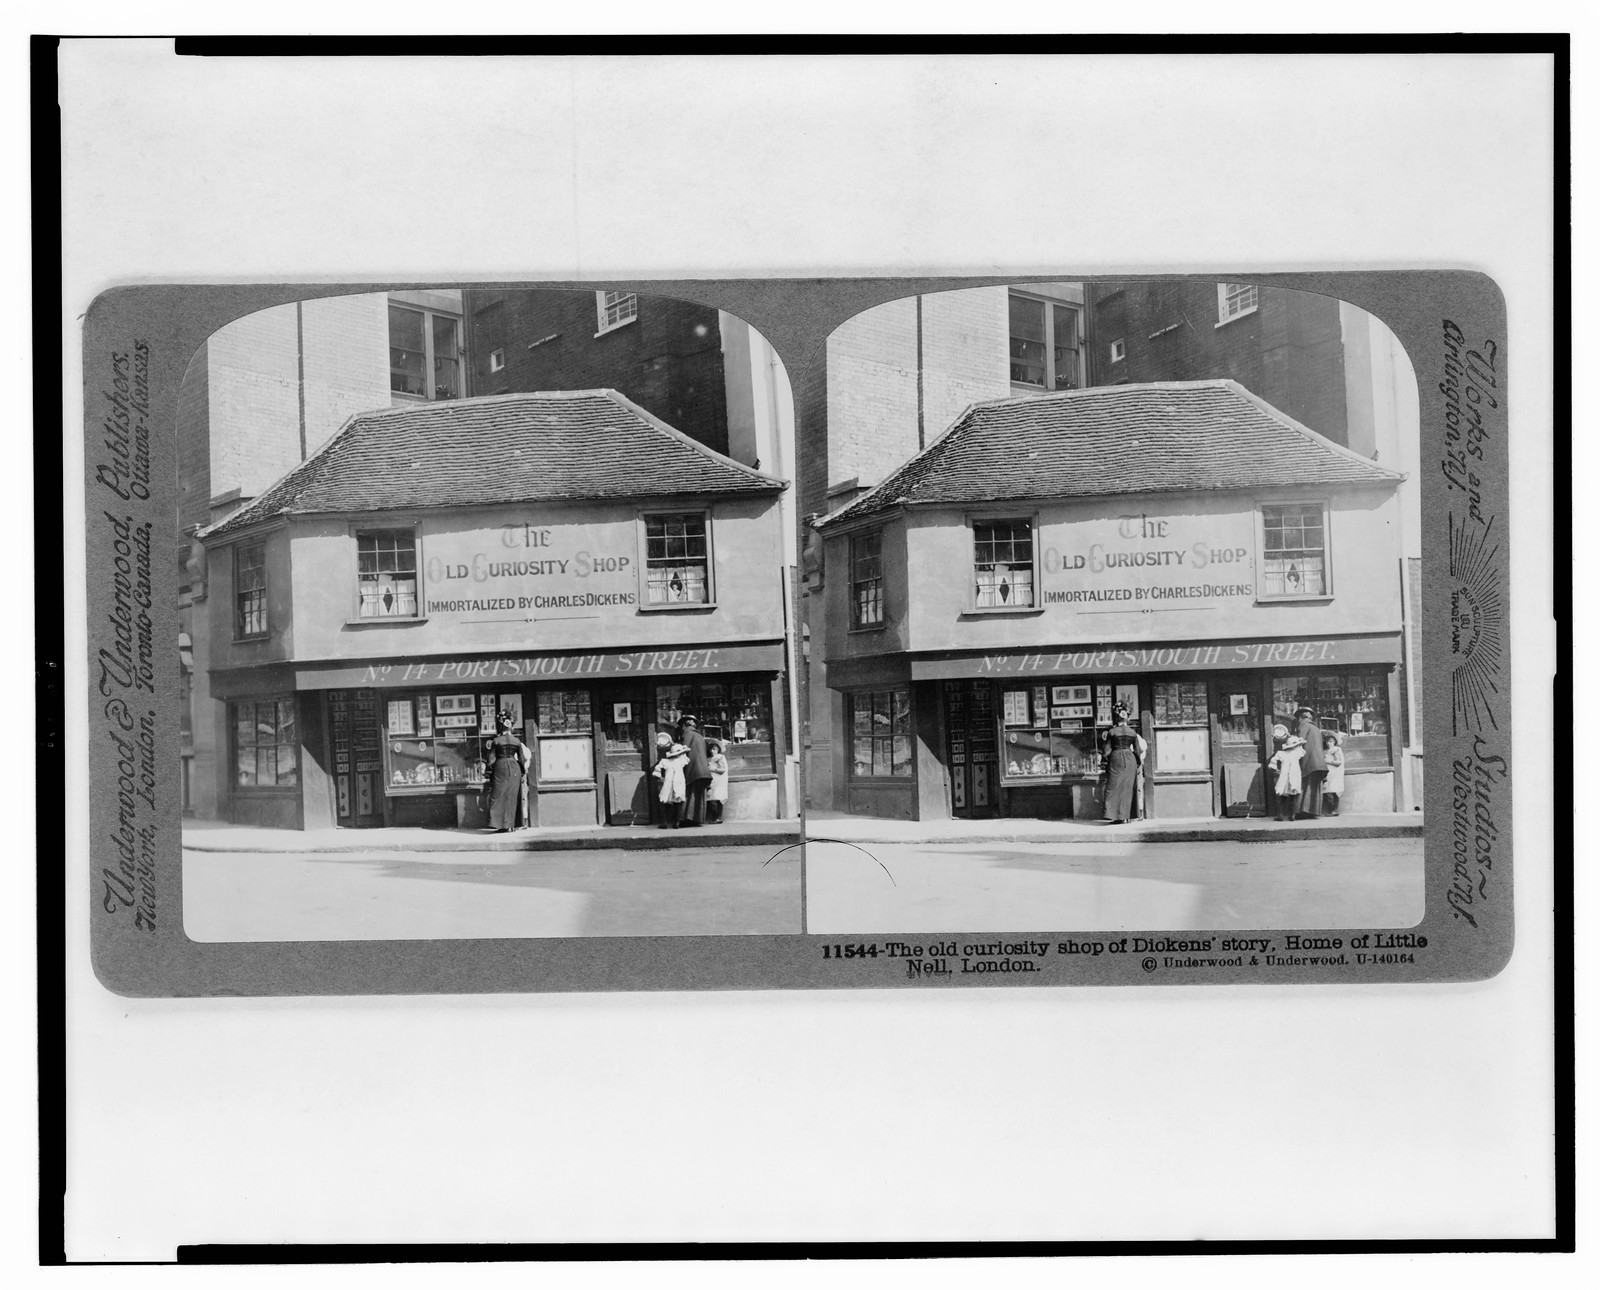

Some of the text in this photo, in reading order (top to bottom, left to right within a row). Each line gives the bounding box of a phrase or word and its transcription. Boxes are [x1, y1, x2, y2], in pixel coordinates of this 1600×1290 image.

[1465, 339, 1497, 525] Works and
[502, 522, 552, 548] The
[1118, 513, 1169, 539] The
[427, 550, 630, 584] OLD CURIOSITY SHOP
[1044, 542, 1247, 574] OLD CURIOSITY SHOP
[98, 511, 133, 697] Underwood,
[428, 593, 635, 612] IMMORTALIZED BY CHARLES DICKENS
[1044, 584, 1252, 603] IMMORTALIZED BY CHARLES DICKENS
[1460, 587, 1481, 658] SUN SCULPTURE
[1452, 625, 1460, 654] MARK
[402, 663, 428, 680] 14
[436, 655, 601, 680] PORTSMOUTH
[615, 649, 719, 672] STREET.
[1018, 653, 1044, 670] 14
[1052, 646, 1222, 670] PORTSMOUTH
[1231, 641, 1336, 664] STREET.
[104, 699, 134, 731] &
[103, 731, 135, 913] Underwood
[928, 942, 958, 956] old
[964, 941, 1050, 956] curiosity
[1058, 940, 1104, 956] shop
[1108, 938, 1128, 953] of
[1132, 937, 1216, 952] Dickens'
[1222, 938, 1276, 952] story,
[1285, 936, 1342, 950] Home
[1350, 934, 1369, 948] of
[1374, 934, 1428, 948] Little
[961, 958, 1040, 973] London.
[1164, 956, 1242, 968] Underwood
[1249, 955, 1258, 966] &
[1265, 954, 1349, 966] Underwood.
[1356, 953, 1415, 964] U-140164
